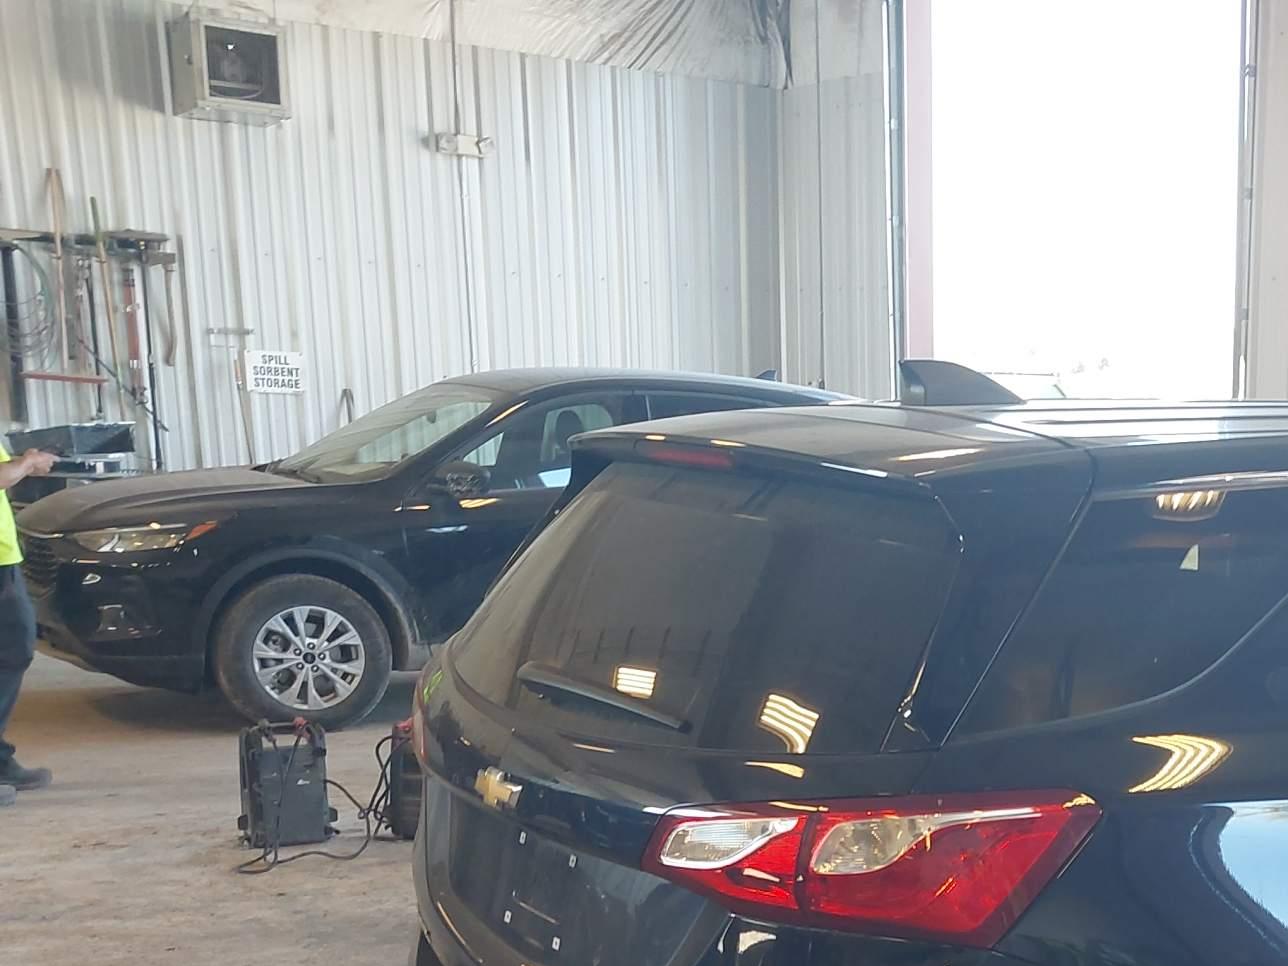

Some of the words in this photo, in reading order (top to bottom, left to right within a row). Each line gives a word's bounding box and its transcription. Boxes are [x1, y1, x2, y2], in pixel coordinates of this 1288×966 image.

[261, 354, 290, 366] SPILL
[252, 365, 301, 378] SORBENT
[253, 377, 302, 390] STORAGE
